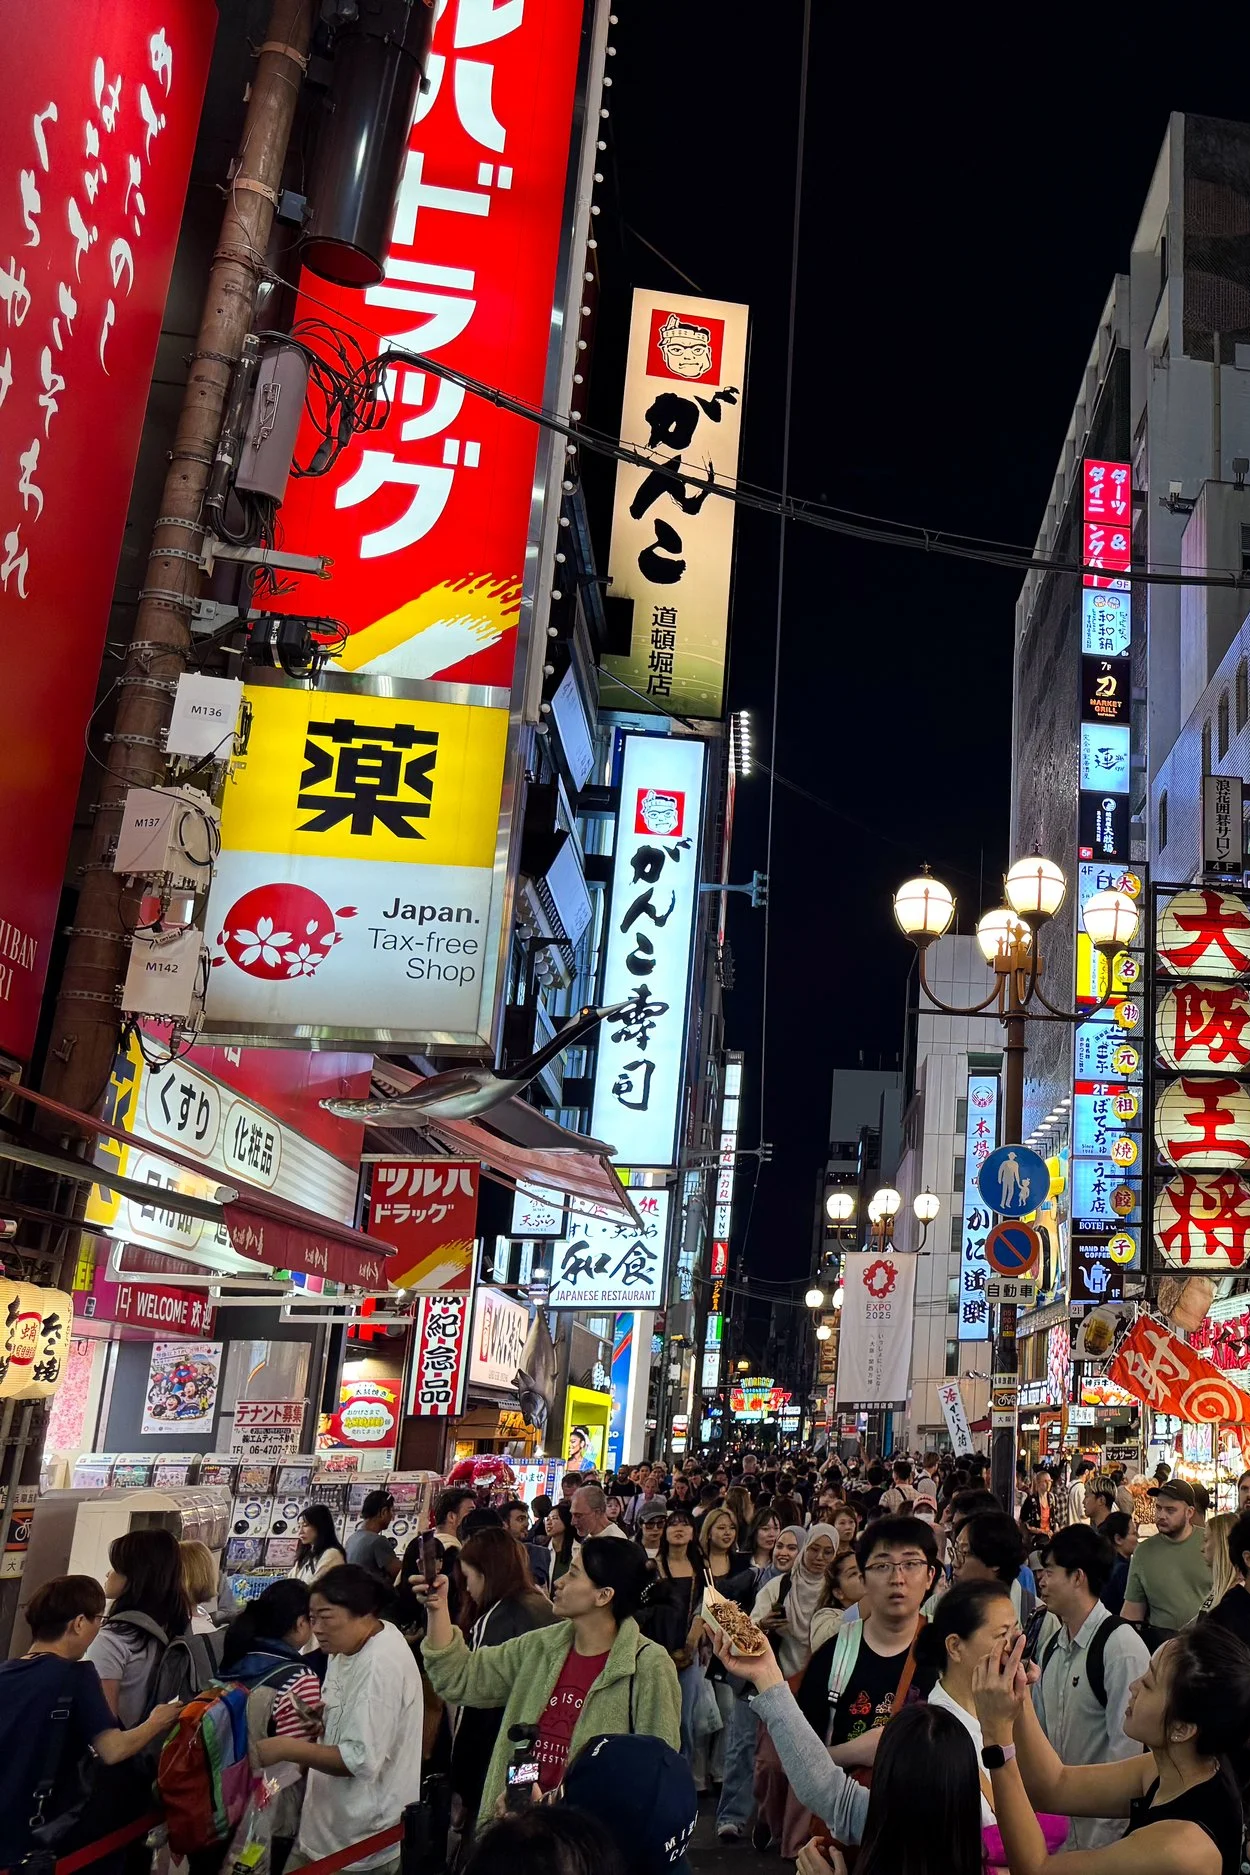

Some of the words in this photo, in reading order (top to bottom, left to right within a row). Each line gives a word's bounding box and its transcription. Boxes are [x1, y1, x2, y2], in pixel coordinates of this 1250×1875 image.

[629, 385, 741, 586] がんこ
[645, 604, 678, 698] 道頓堀店
[1100, 661, 1112, 671] 7F
[190, 704, 223, 719] M136
[1090, 699, 1122, 708] MARKET
[1094, 706, 1118, 714] GRILL
[294, 717, 440, 840] 薬
[135, 817, 161, 829] M137
[1216, 778, 1231, 861] 浪花囲碁サロン
[1081, 866, 1093, 876] 4F
[381, 898, 481, 926] Japan.
[367, 927, 480, 956] Tax-free
[145, 960, 180, 975] M142
[405, 957, 477, 988] Shop
[1092, 1084, 1109, 1095] 2F
[159, 1071, 212, 1141] くすり
[233, 1114, 277, 1176] 化粧品
[377, 1167, 475, 1198] ツルハ
[1089, 1162, 1109, 1214] う本店
[374, 1202, 456, 1225] ドラッグ
[519, 1214, 556, 1228] 天ぷら
[717, 1206, 727, 1237] NYNY
[560, 1240, 658, 1287] 和食
[555, 1289, 599, 1301] JAPANESE
[601, 1289, 656, 1301] RESTAURANT
[987, 1283, 1034, 1299] 自動車
[1111, 1289, 1121, 1298] 1F
[137, 1292, 189, 1324] WELCOME
[866, 1303, 892, 1311] EXPO
[866, 1311, 891, 1320] 2025
[33, 1312, 63, 1383] たこ焼
[236, 1405, 303, 1423] テナント募集
[1107, 1451, 1138, 1459] マッサージ
